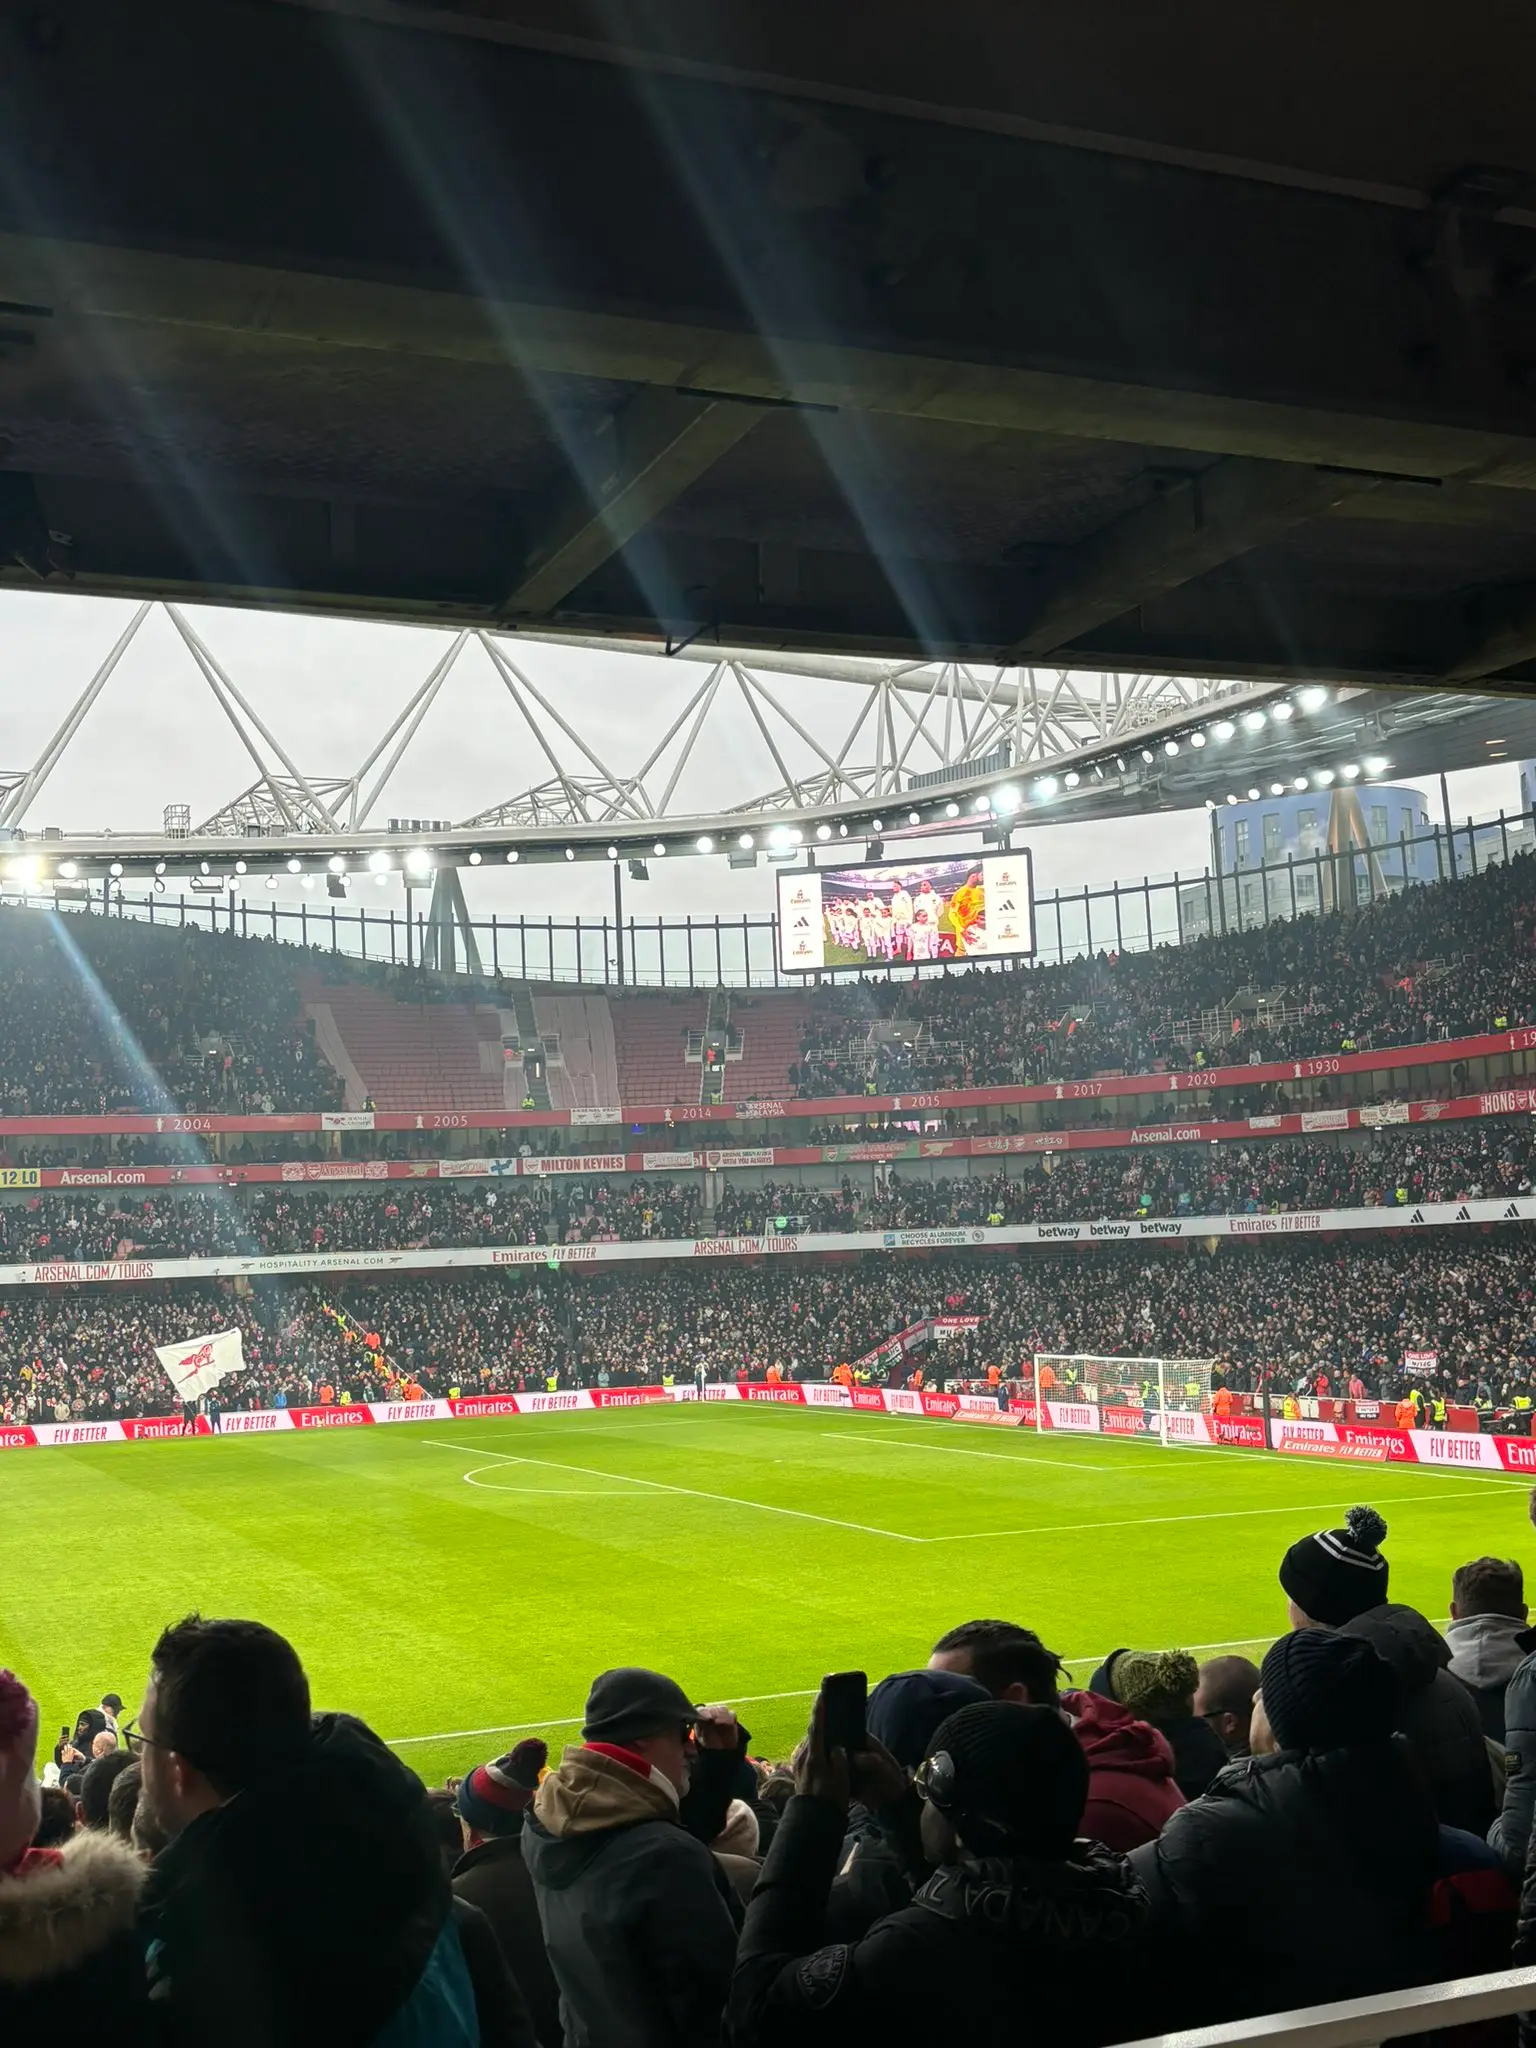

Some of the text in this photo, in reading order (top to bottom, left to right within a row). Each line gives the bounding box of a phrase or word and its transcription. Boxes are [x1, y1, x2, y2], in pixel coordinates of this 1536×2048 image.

[1308, 1059, 1340, 1075] 1930
[1187, 1072, 1216, 1087] 2020
[1073, 1083, 1102, 1096] 2017
[911, 1095, 940, 1108] 2015
[1485, 1092, 1515, 1114] HONG
[433, 1115, 468, 1127] 2005
[682, 1107, 712, 1119] 2014
[173, 1118, 212, 1131] 2004
[1130, 1127, 1201, 1144] Arsenal.com
[541, 1157, 624, 1172] MILTON KEYNES
[60, 1170, 146, 1185] Arsenal.com
[1038, 1221, 1182, 1239] betway betway betway
[1229, 1215, 1321, 1233] Emirates FLY BETTER
[693, 1237, 798, 1256] ARSENAL.COM/TOURS
[259, 1256, 384, 1269] HOSPITALITY.ARSENAL.COM
[492, 1247, 597, 1264] Emirates FLY BETTER
[34, 1262, 153, 1282] ARSENAL.COM/TOURS
[748, 1387, 800, 1402] Emirates
[854, 1392, 881, 1407] Emirates
[454, 1401, 514, 1417] Emirates
[532, 1396, 578, 1411] FLY BETTER
[925, 1396, 957, 1413] Emirates
[388, 1405, 436, 1420] FLY BETTER
[1060, 1407, 1091, 1424] FLY BETTER
[226, 1415, 277, 1431] FLY BETTER
[54, 1426, 108, 1443] FLY BETTER
[1283, 1440, 1336, 1454] Emirates
[1353, 1446, 1383, 1458] BETTER
[1346, 1431, 1405, 1455] Emirates
[1430, 1438, 1482, 1462] FLY BETTER
[964, 1882, 1132, 1943] CANADA
